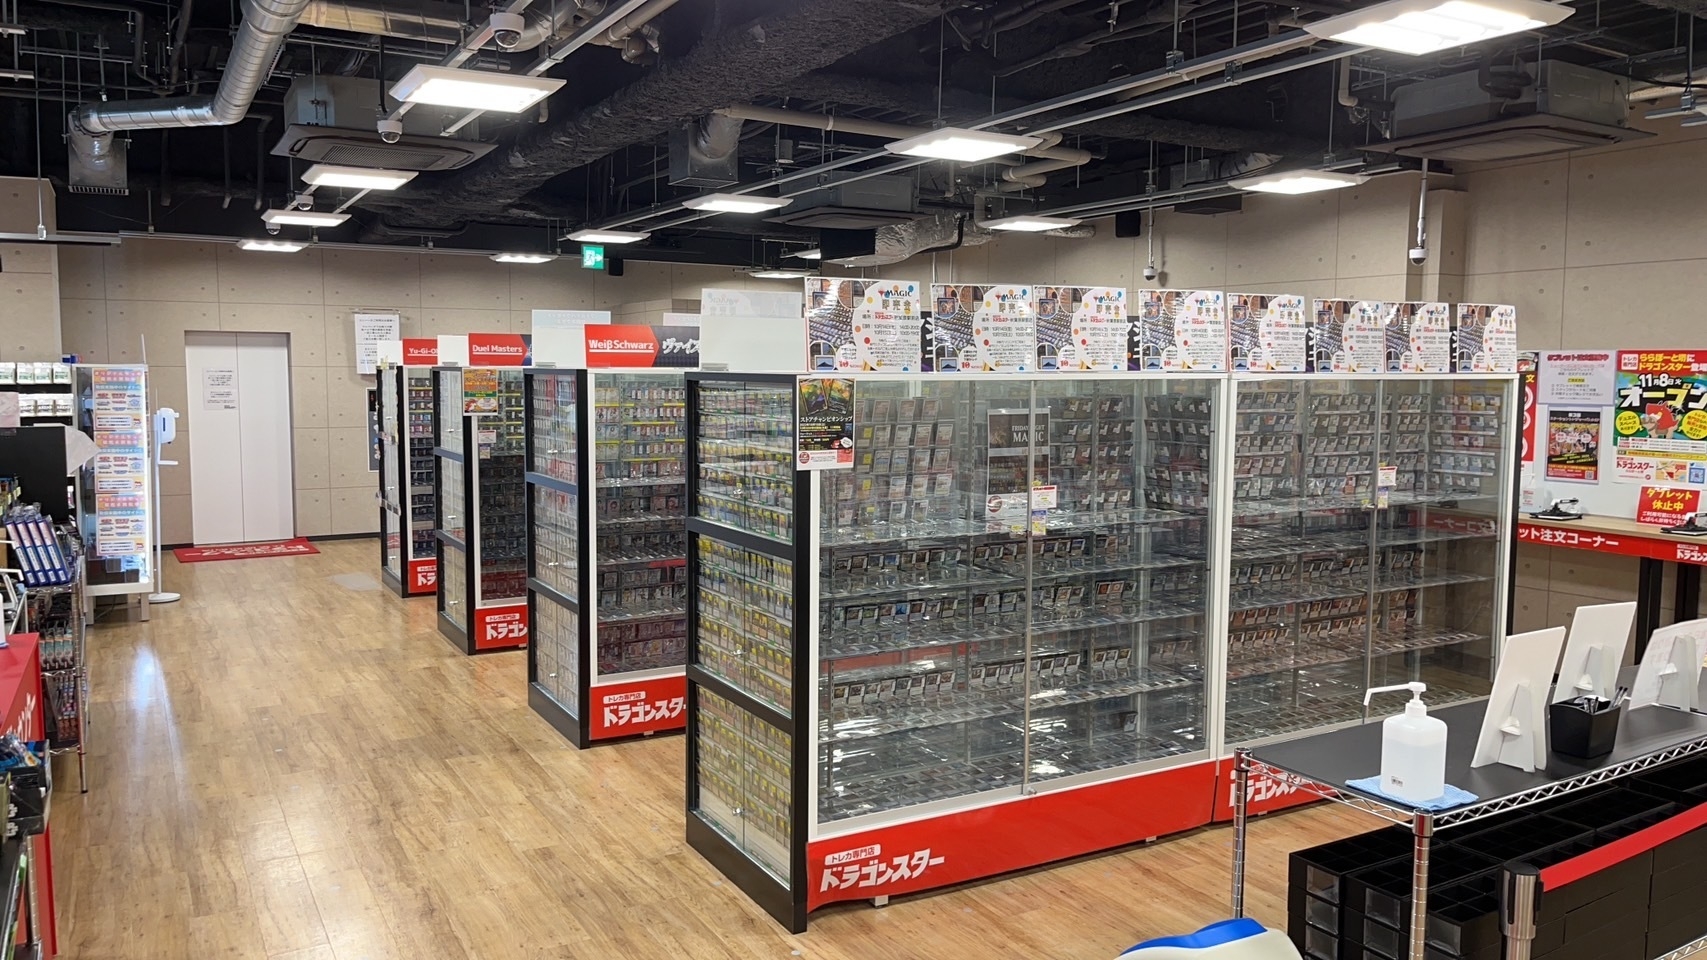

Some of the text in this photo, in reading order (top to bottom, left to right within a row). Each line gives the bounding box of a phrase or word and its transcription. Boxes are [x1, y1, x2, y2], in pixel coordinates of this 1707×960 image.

[472, 344, 523, 353] Duel Masters
[1620, 383, 1707, 409] オープン
[1013, 432, 1044, 442] MAIC
[1647, 487, 1693, 500] タブレット
[1652, 499, 1684, 511] 休止中
[1519, 527, 1619, 548] ット注文コーナー
[486, 621, 528, 641] ドラゴン
[608, 692, 642, 702] トレカ専門店
[831, 846, 875, 863] トレカ専門店
[820, 848, 945, 893] ドラゴンスター
